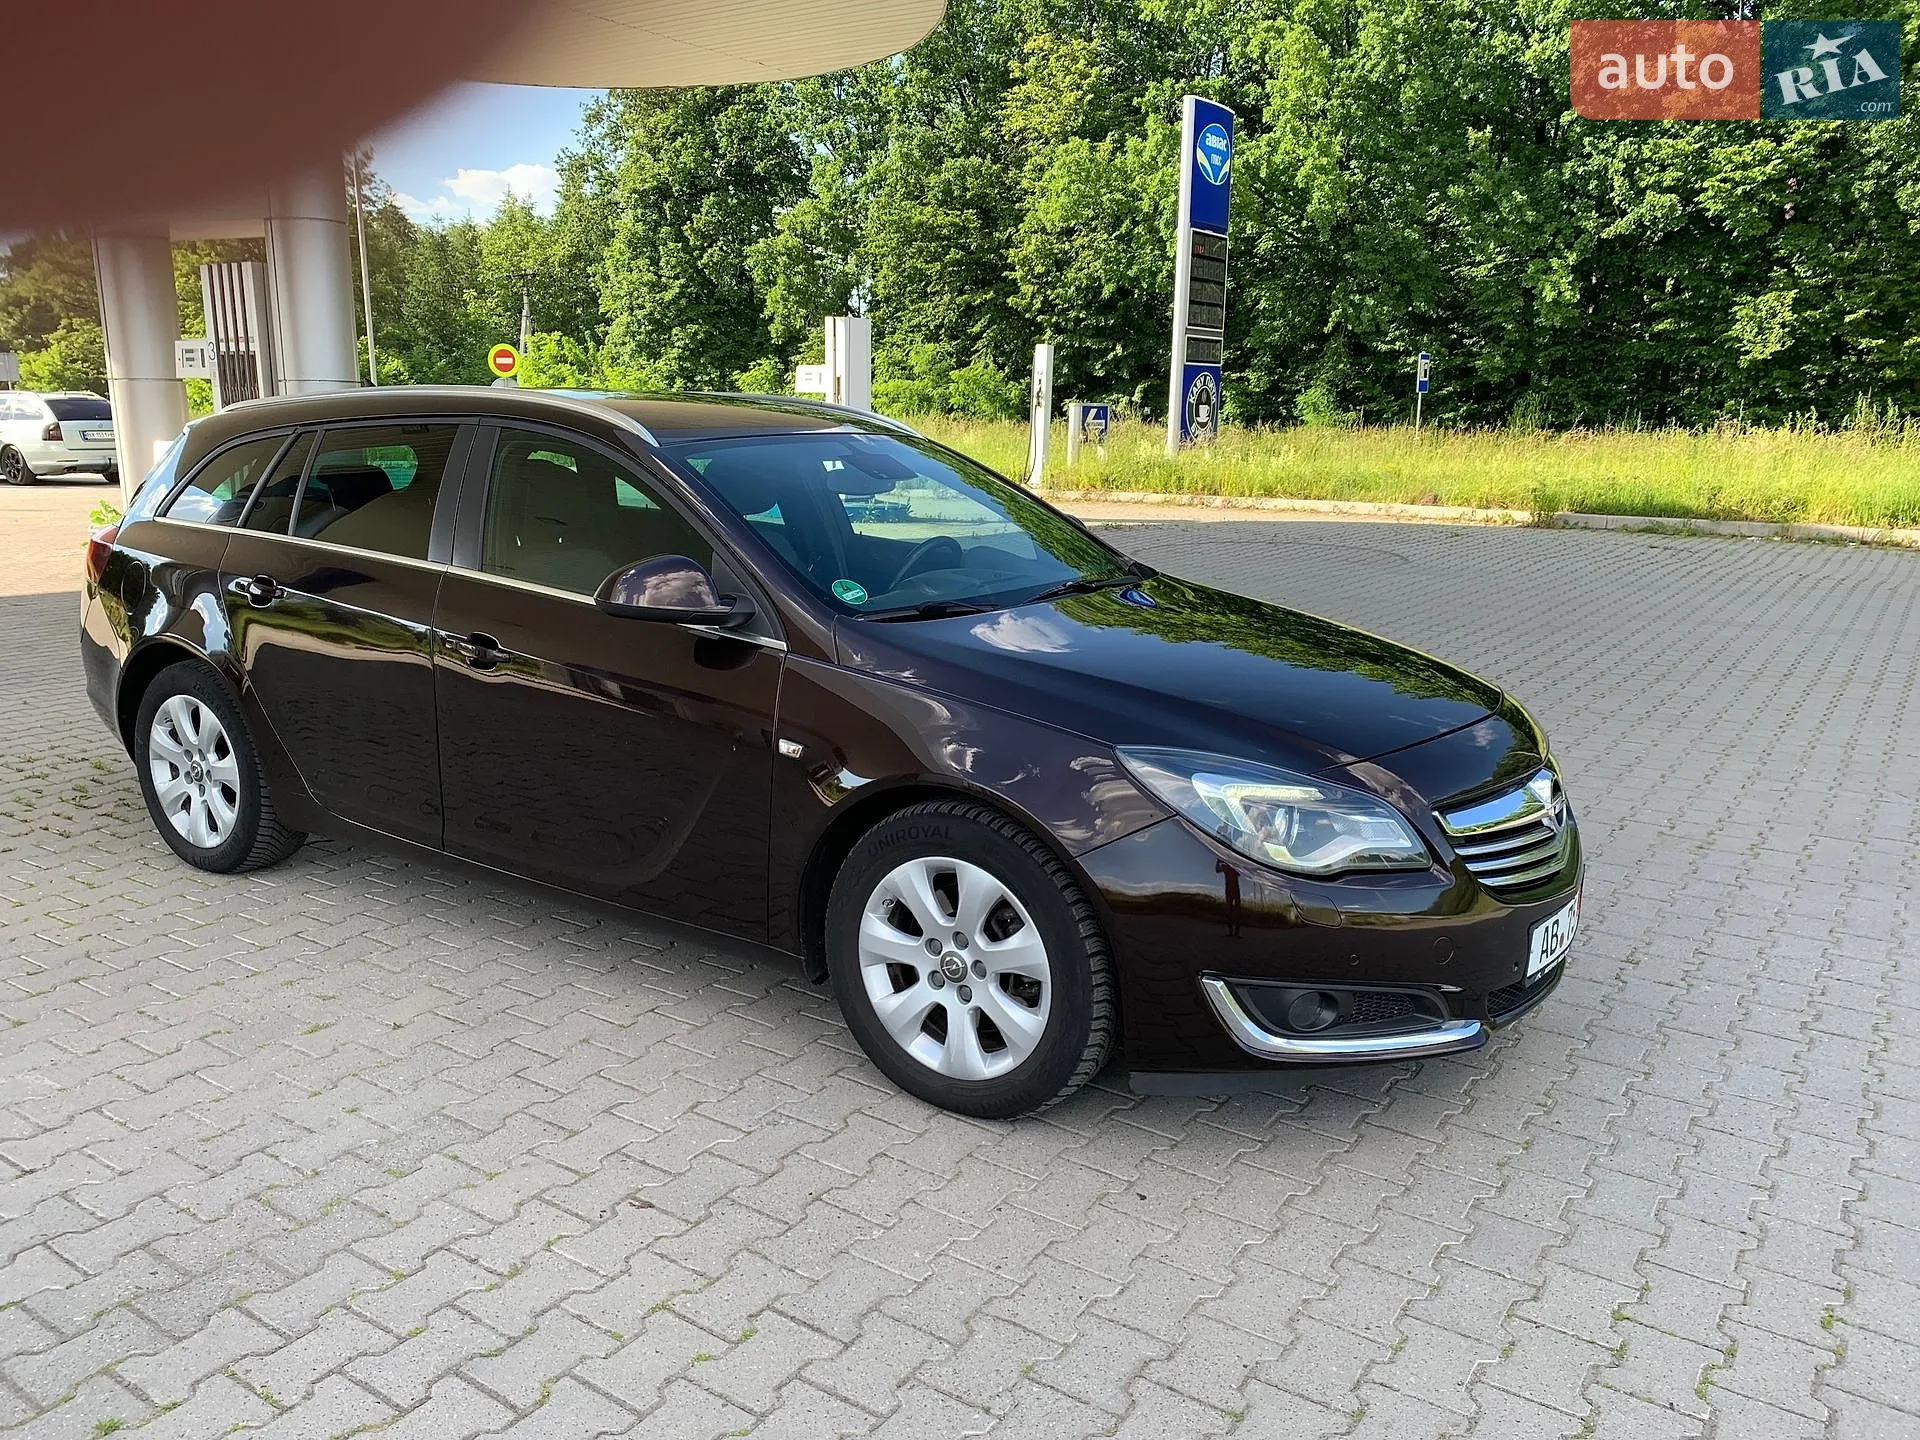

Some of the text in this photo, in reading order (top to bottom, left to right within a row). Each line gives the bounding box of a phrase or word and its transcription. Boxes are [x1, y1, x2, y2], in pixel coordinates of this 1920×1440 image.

[208, 341, 216, 361] 3
[867, 825, 954, 857] UNIROYAL
[1539, 918, 1560, 964] AB
